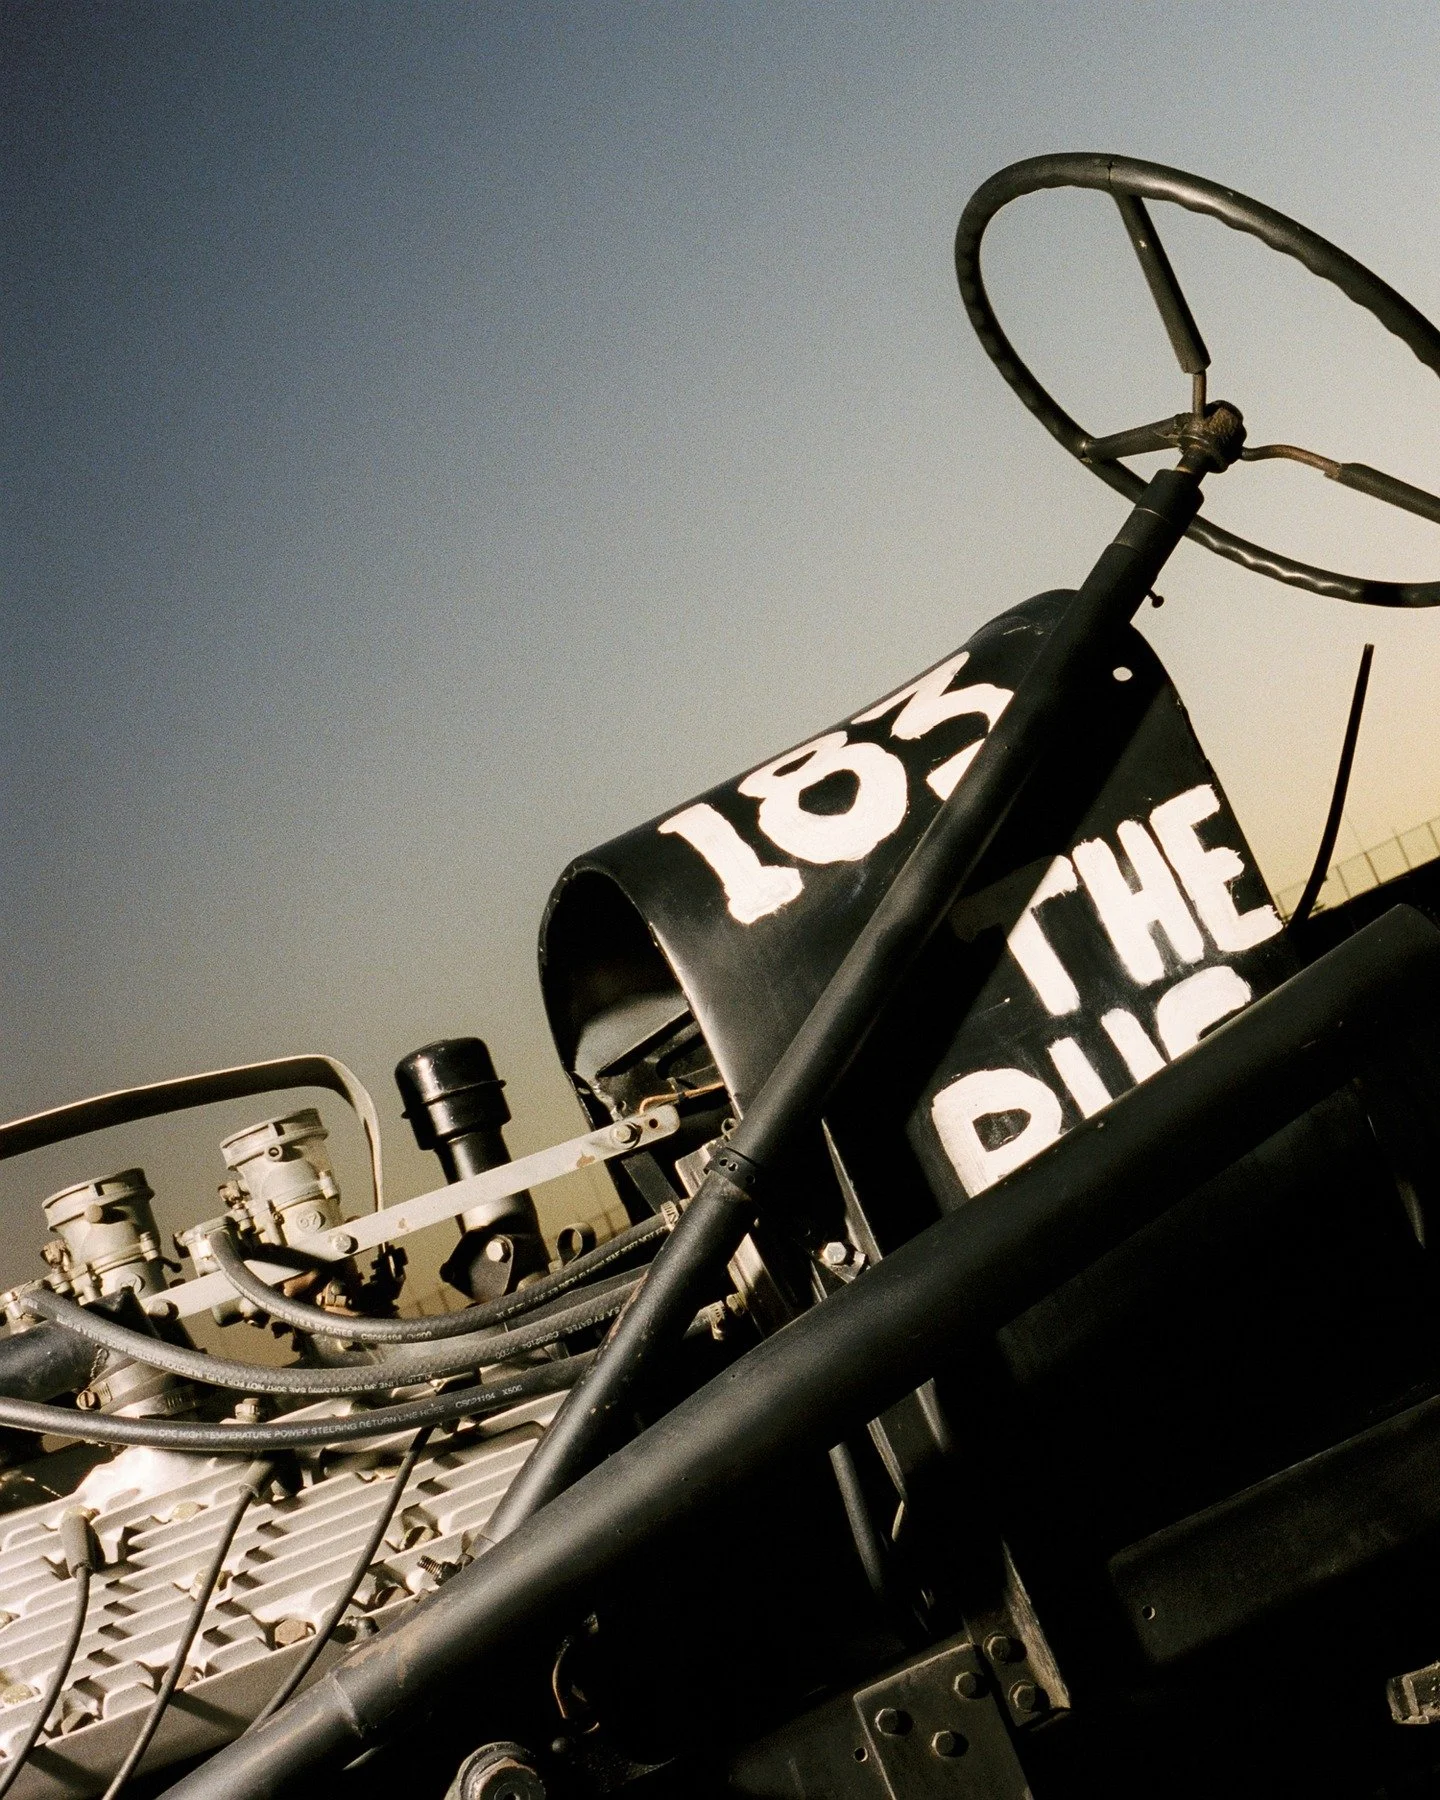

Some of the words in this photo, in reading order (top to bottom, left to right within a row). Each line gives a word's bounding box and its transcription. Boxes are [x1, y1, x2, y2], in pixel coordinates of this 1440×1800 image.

[657, 651, 1015, 925] 183
[948, 784, 1284, 1017] THE
[225, 1375, 245, 1388] FOR
[245, 1381, 264, 1390] NOT
[179, 1430, 202, 1438] HIGH
[203, 1430, 271, 1439] TEMPERATURE
[274, 1428, 308, 1437] POWER
[310, 1423, 357, 1435] STEERING
